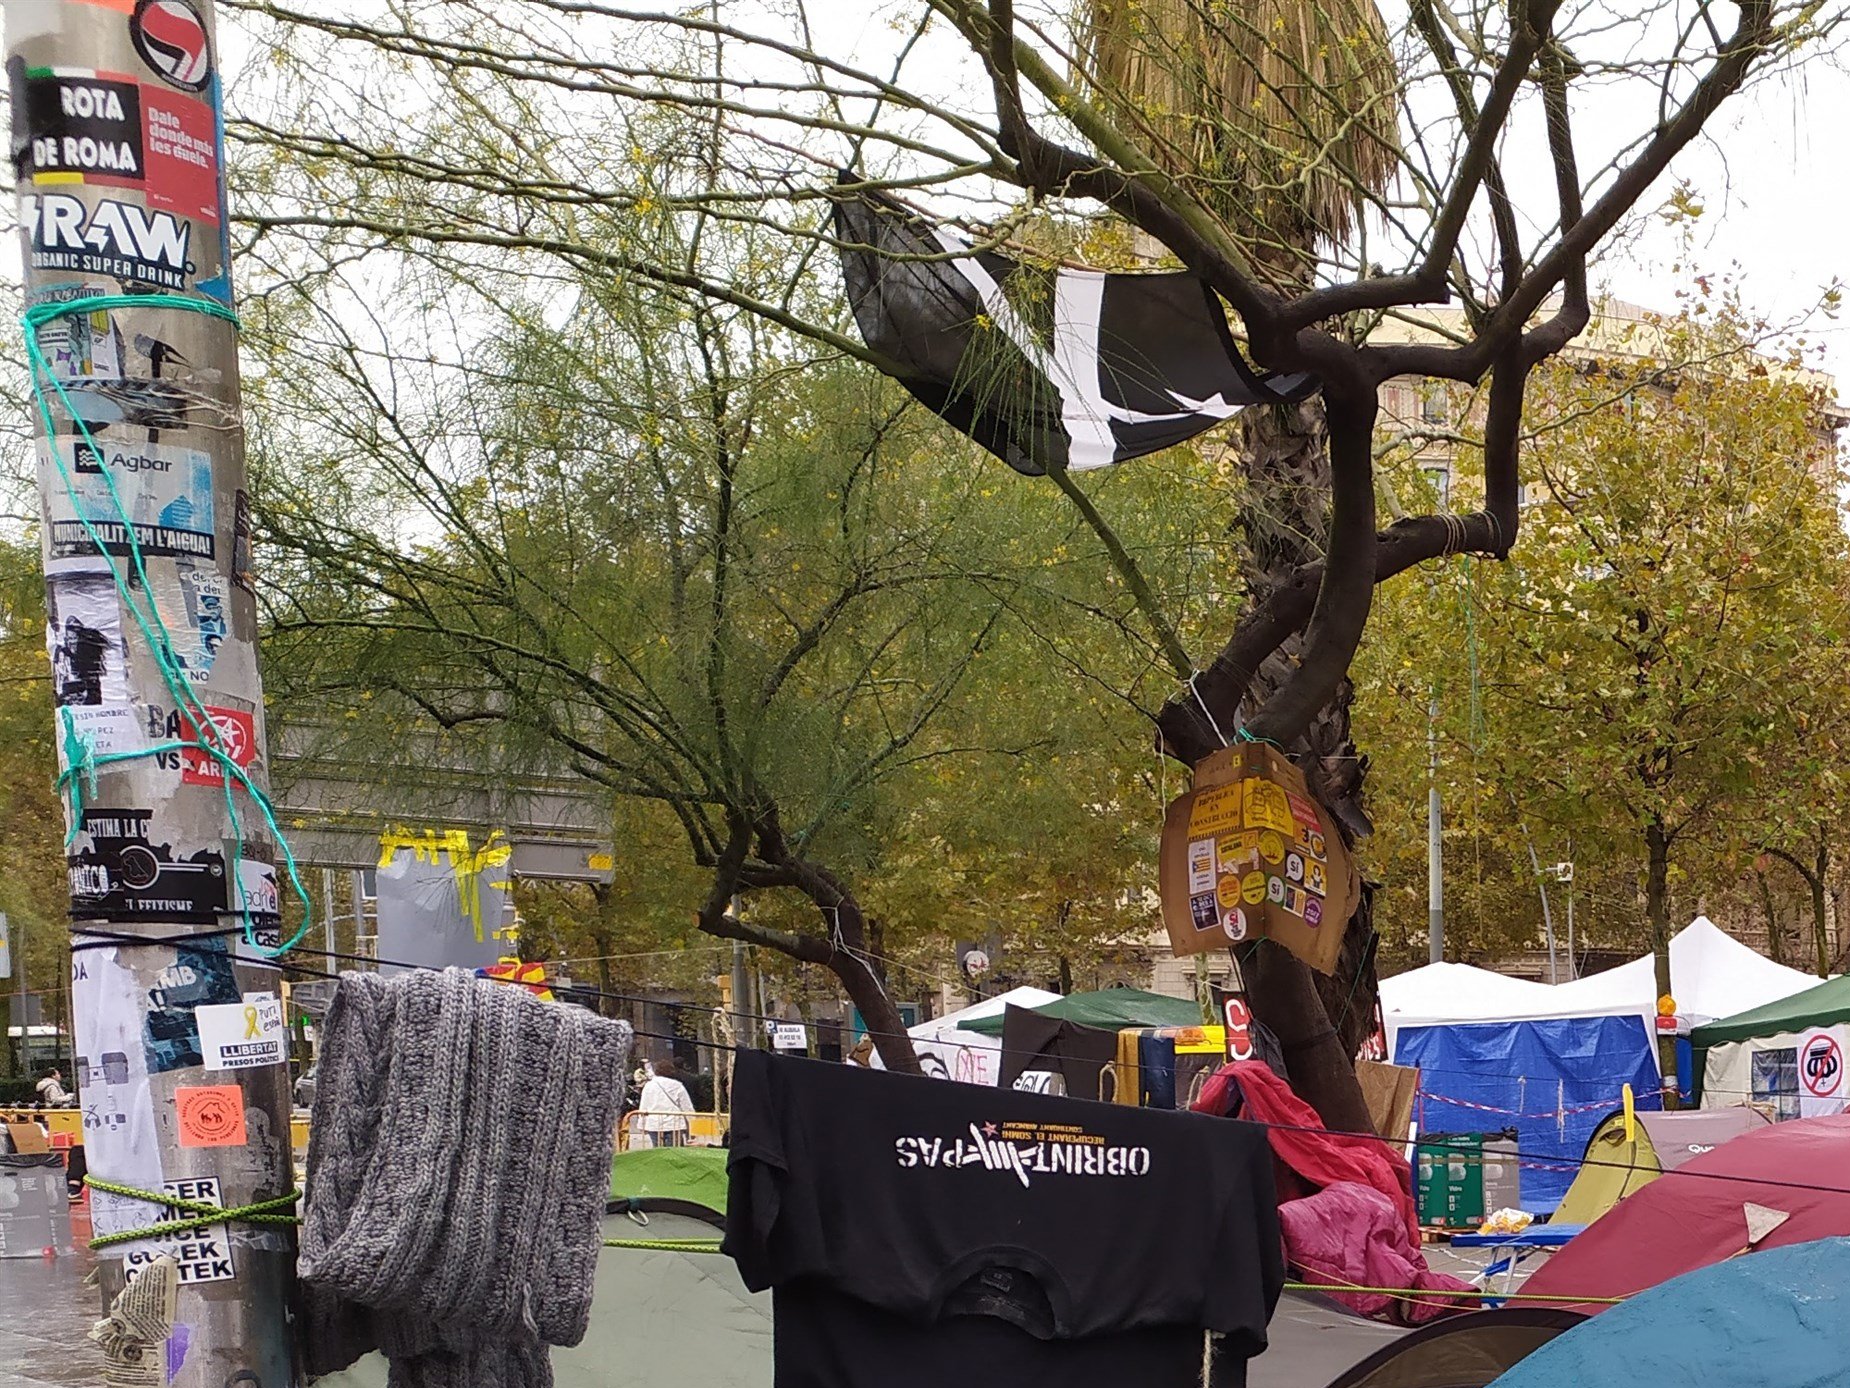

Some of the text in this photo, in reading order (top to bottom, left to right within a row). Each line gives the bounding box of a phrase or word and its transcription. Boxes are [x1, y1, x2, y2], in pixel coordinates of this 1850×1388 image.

[60, 86, 125, 121] ROTA
[148, 107, 180, 129] Dale
[149, 122, 192, 148] donde
[32, 136, 138, 172] DE ROMA
[82, 257, 132, 276] SUPER
[137, 264, 183, 288] DRINK
[110, 452, 173, 472] Agbar
[222, 1041, 278, 1057] LLIBERTAT
[222, 1058, 255, 1067] PRESOS
[1047, 1133, 1105, 1144] RECUPERANT
[895, 1137, 1150, 1176] OBRINT PAS
